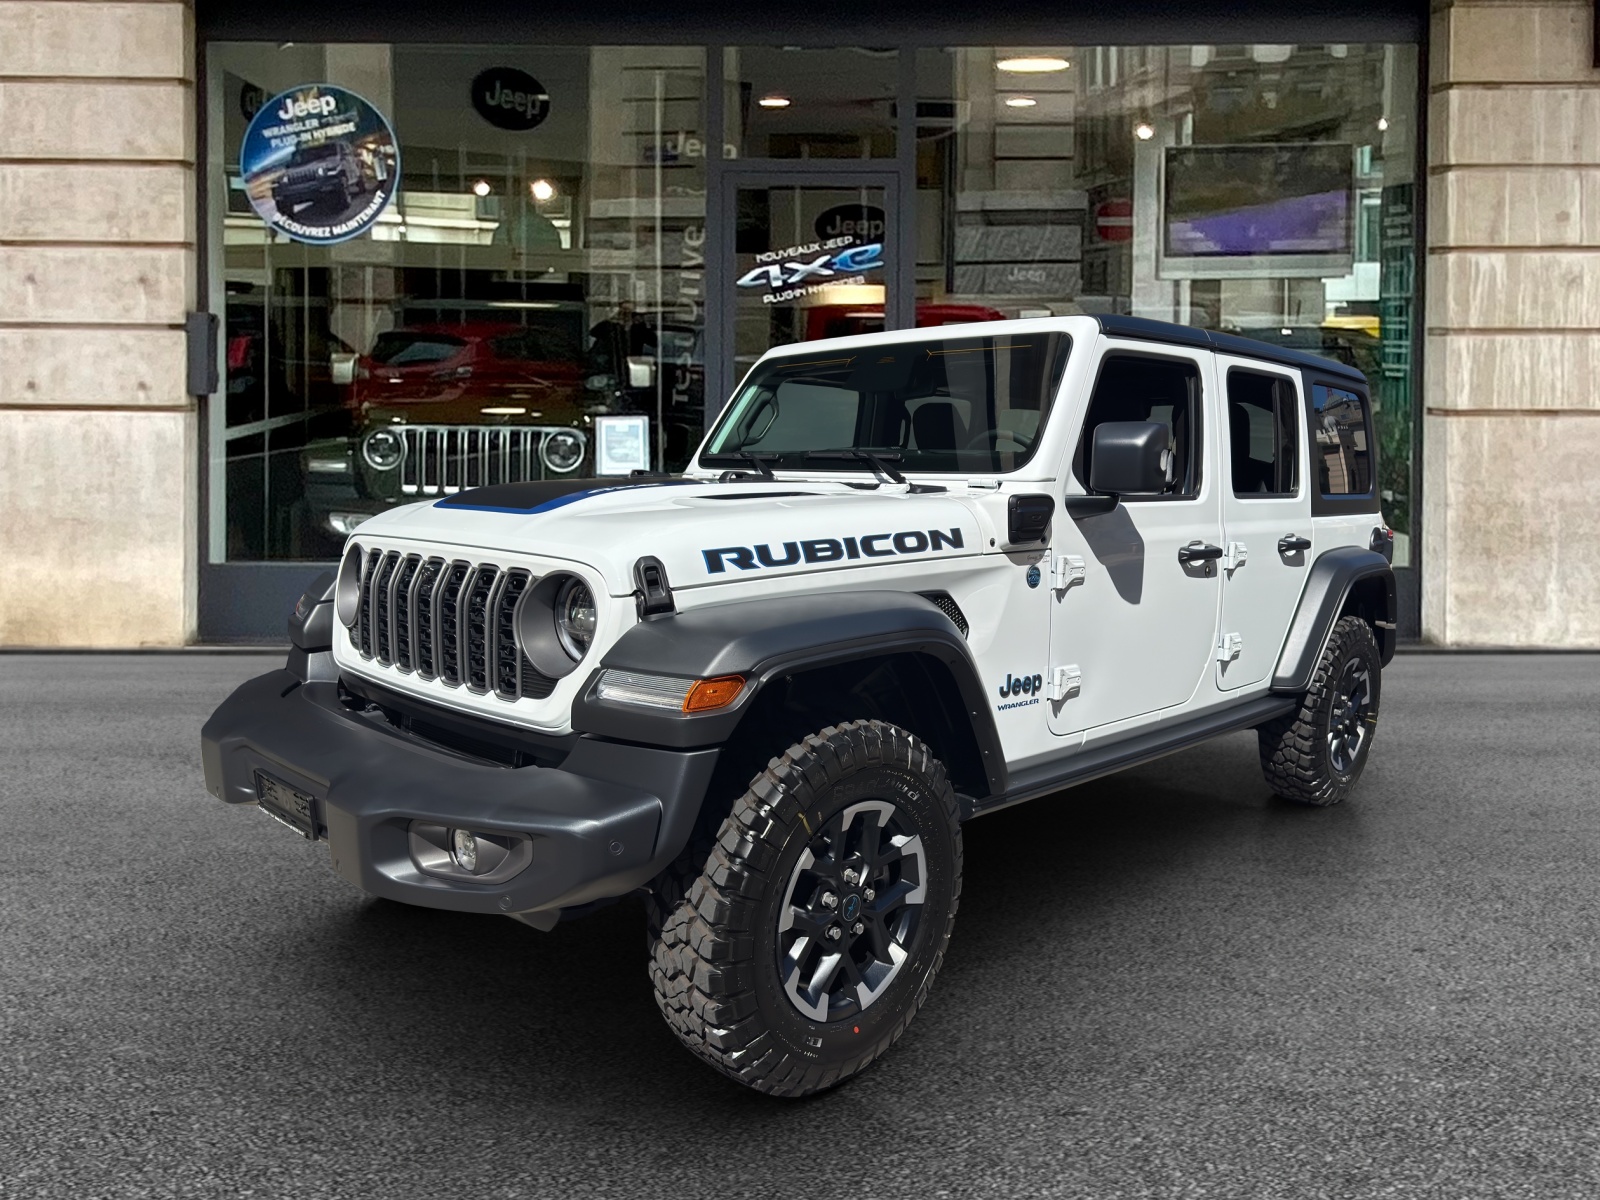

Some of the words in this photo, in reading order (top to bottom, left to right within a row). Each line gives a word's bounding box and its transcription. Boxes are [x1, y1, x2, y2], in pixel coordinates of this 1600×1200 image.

[278, 95, 336, 119] Jeep
[485, 80, 541, 119] Jeep
[262, 119, 319, 138] WRANGLER
[332, 190, 385, 236] MAINTENANT
[826, 215, 884, 239] Jeep
[756, 243, 820, 263] NOUVEAUX
[823, 236, 854, 250] JEEP
[702, 527, 964, 574] RUBICON
[999, 673, 1042, 698] Jeep
[998, 698, 1039, 711] WRANGLER
